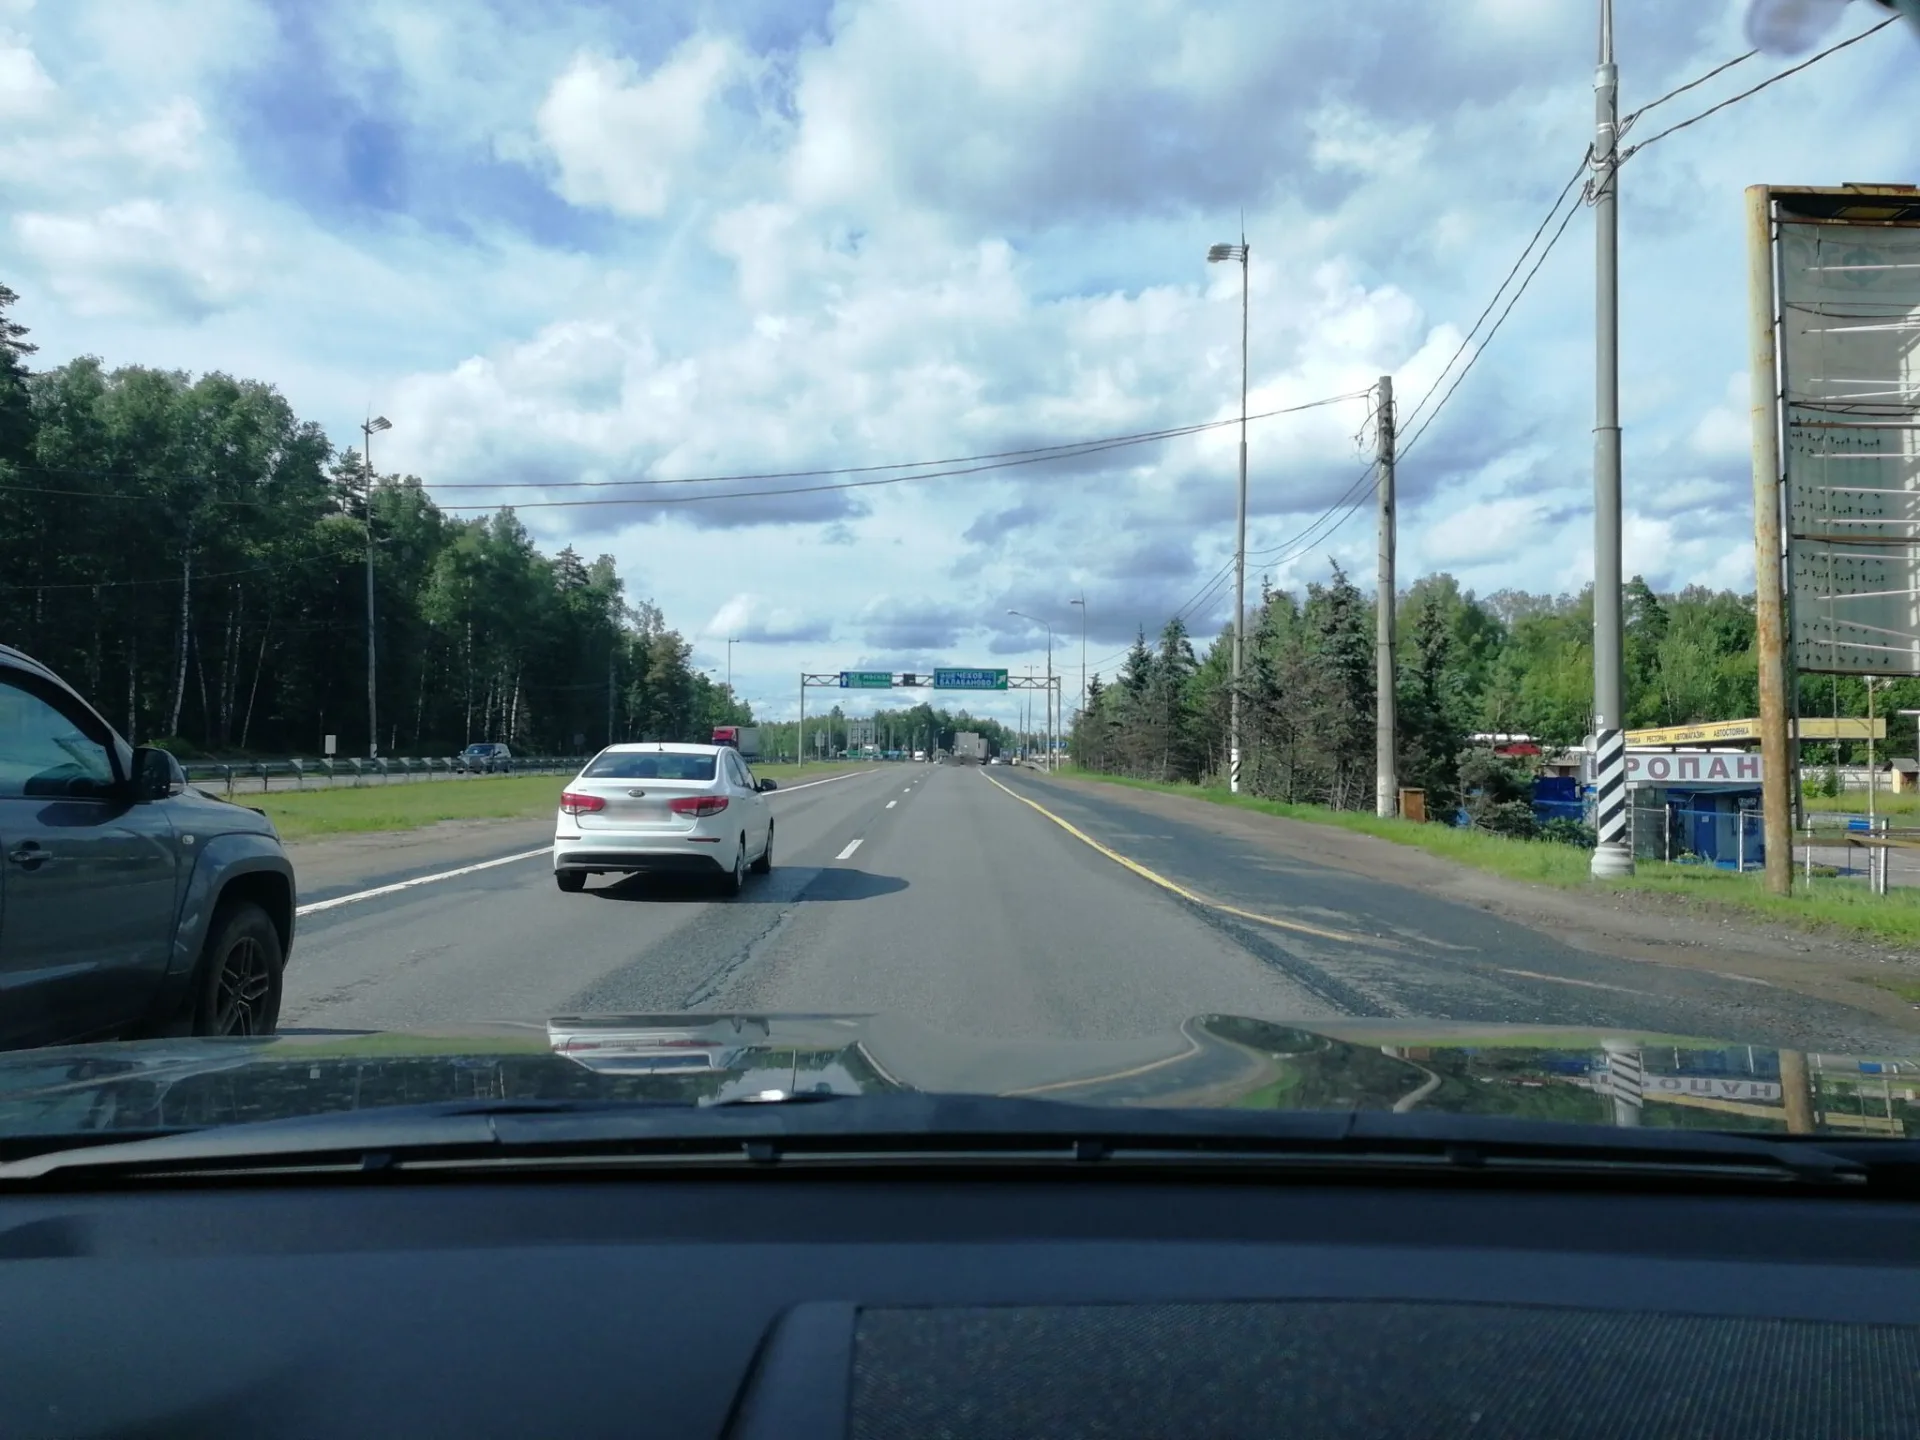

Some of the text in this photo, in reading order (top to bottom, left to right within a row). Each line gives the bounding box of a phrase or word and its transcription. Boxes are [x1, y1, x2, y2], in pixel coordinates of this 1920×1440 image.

[1647, 735, 1667, 743] РЕСТОРАН
[1674, 731, 1706, 741] АВТОМАГАЗИН
[1713, 727, 1750, 738] АВТОСТОЯНКА
